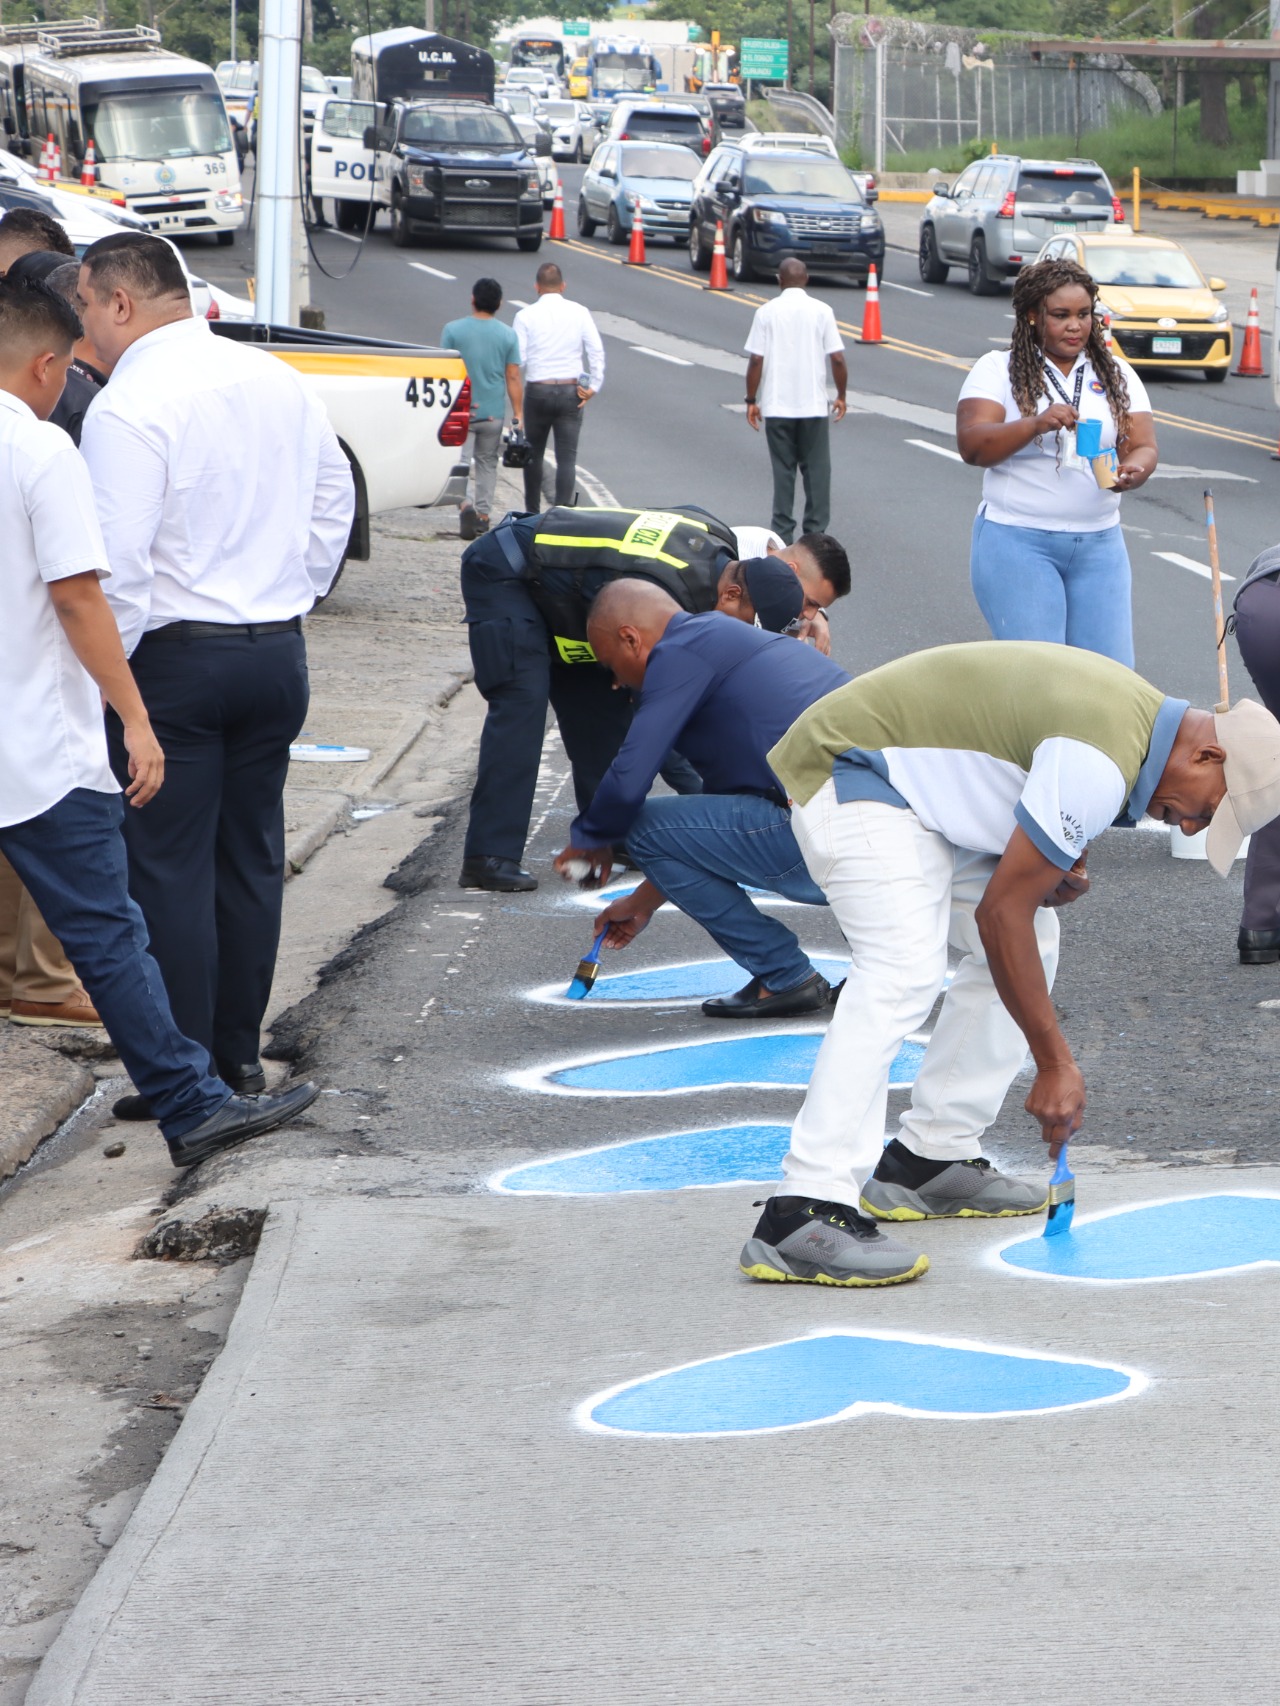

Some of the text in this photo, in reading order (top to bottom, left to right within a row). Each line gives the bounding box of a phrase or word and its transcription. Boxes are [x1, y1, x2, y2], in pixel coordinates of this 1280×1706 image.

[418, 51, 456, 63] U.C.M.
[204, 163, 226, 175] 369
[406, 376, 452, 408] 453
